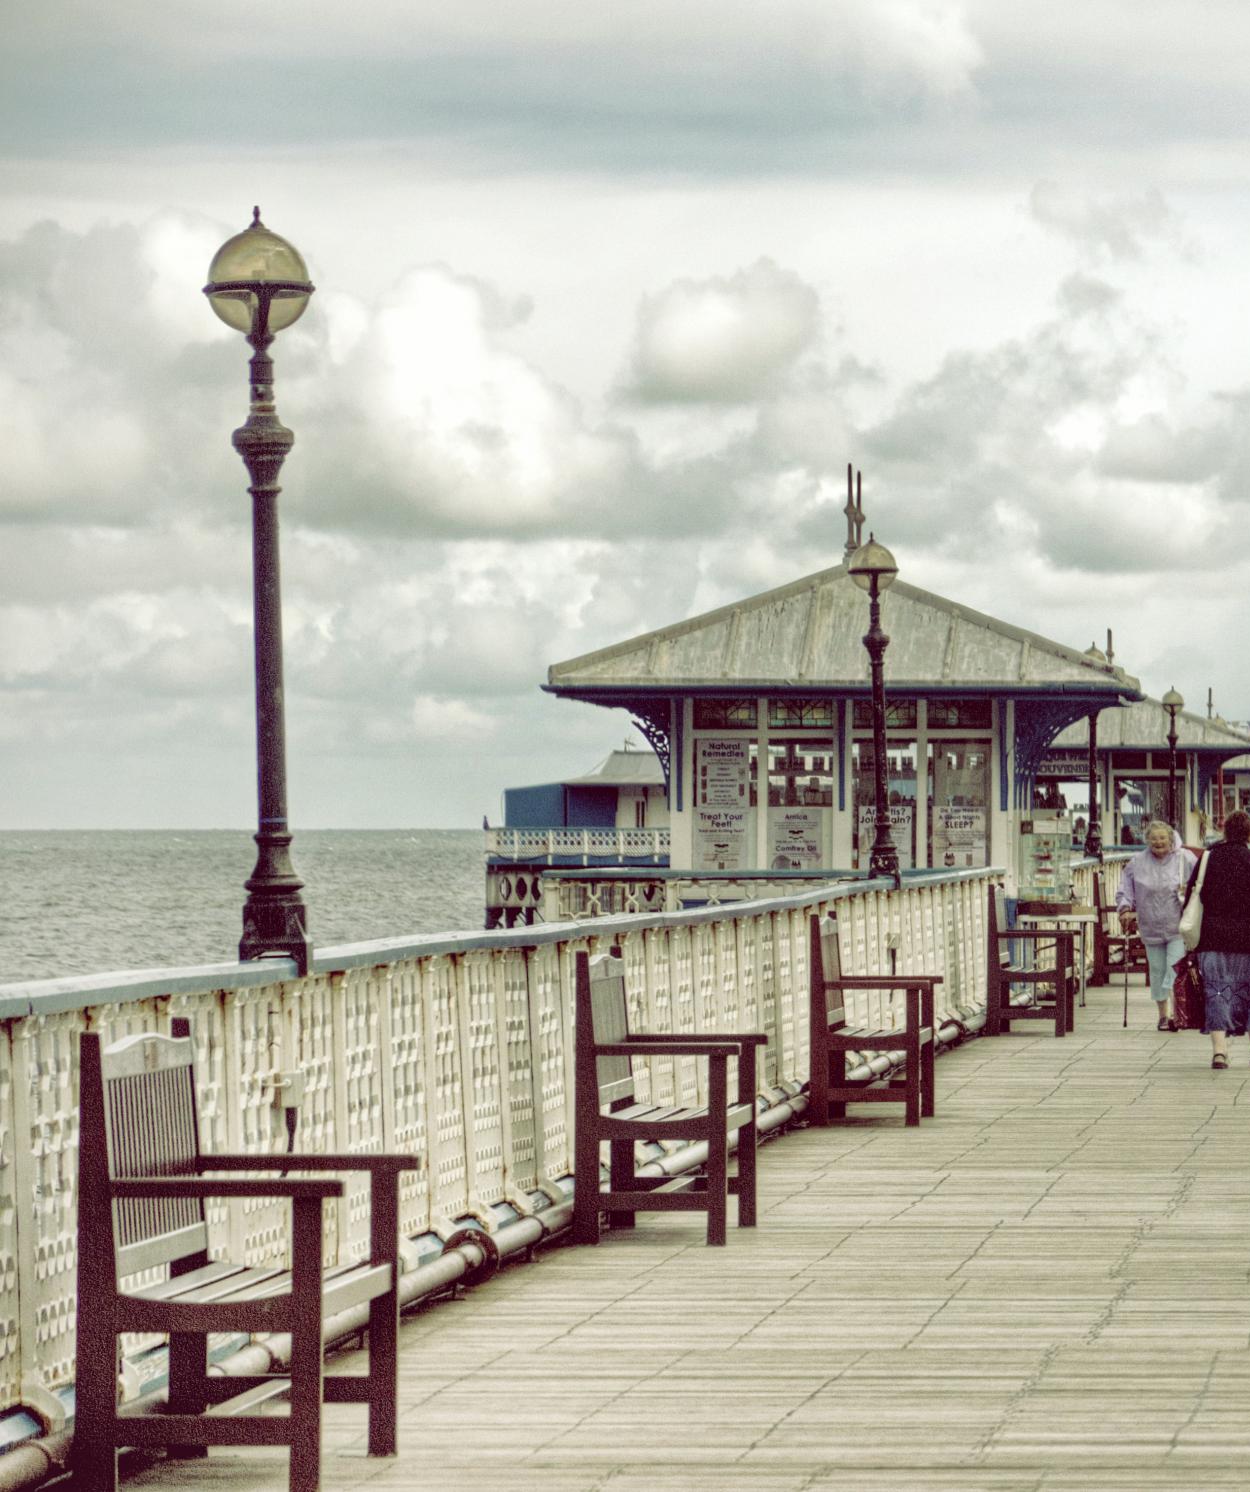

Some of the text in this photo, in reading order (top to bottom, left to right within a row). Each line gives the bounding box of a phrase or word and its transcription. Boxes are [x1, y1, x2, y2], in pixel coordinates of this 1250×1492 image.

[709, 742, 741, 750] Natural
[702, 750, 745, 758] Remedies
[700, 812, 743, 821] Treat Your
[945, 821, 974, 829] SLEEP?
[776, 844, 805, 852] Comfrey
